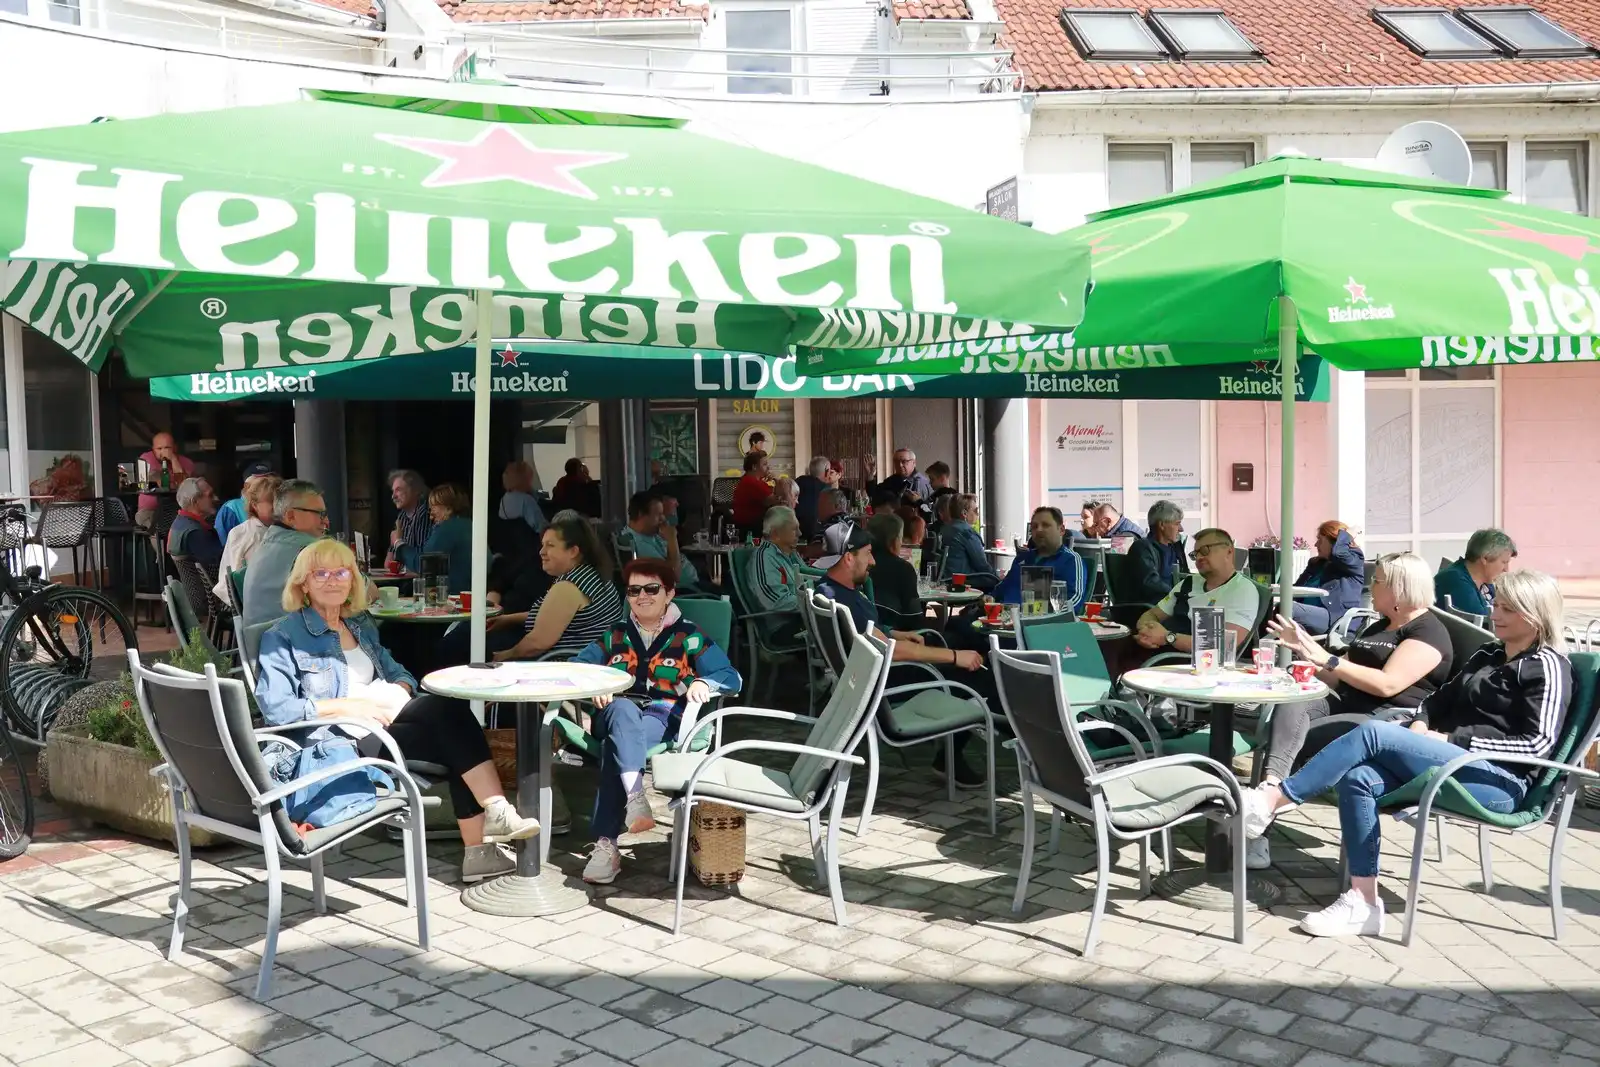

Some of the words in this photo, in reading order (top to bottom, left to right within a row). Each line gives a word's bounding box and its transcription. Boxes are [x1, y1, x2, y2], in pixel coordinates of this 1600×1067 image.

[342, 161, 406, 180] EST.
[9, 157, 957, 314] Heineken
[1327, 304, 1395, 323] Heineken
[190, 371, 315, 394] Heineken
[451, 371, 569, 393] Hneken
[1025, 373, 1119, 393] Heineken
[1219, 376, 1305, 395] Heinekn
[733, 399, 779, 414] SALON
